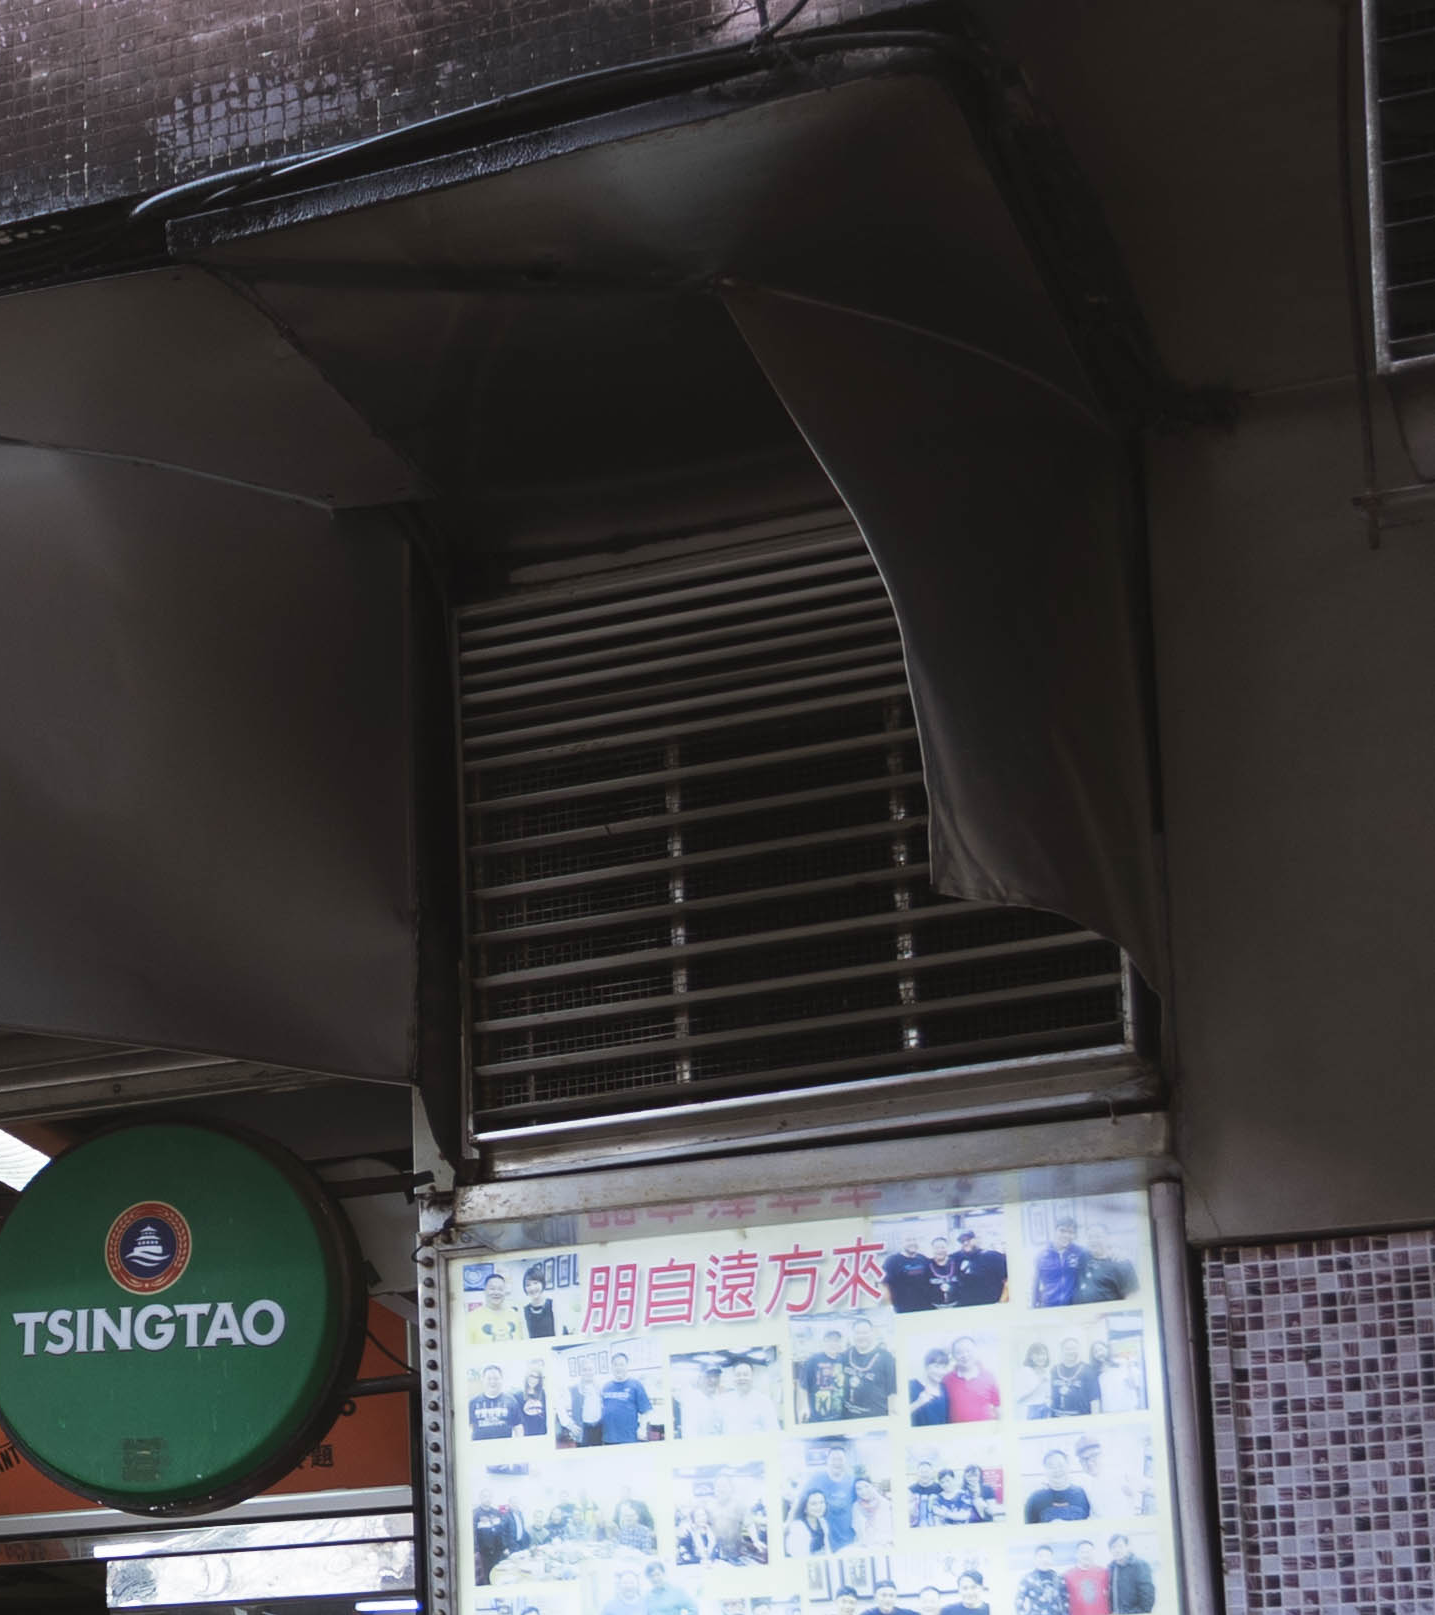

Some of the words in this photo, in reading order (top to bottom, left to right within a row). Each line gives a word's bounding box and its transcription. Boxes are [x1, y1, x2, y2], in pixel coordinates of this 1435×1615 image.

[581, 1237, 885, 1333] 朋自遠方來
[13, 1299, 286, 1357] TSINGTAO
